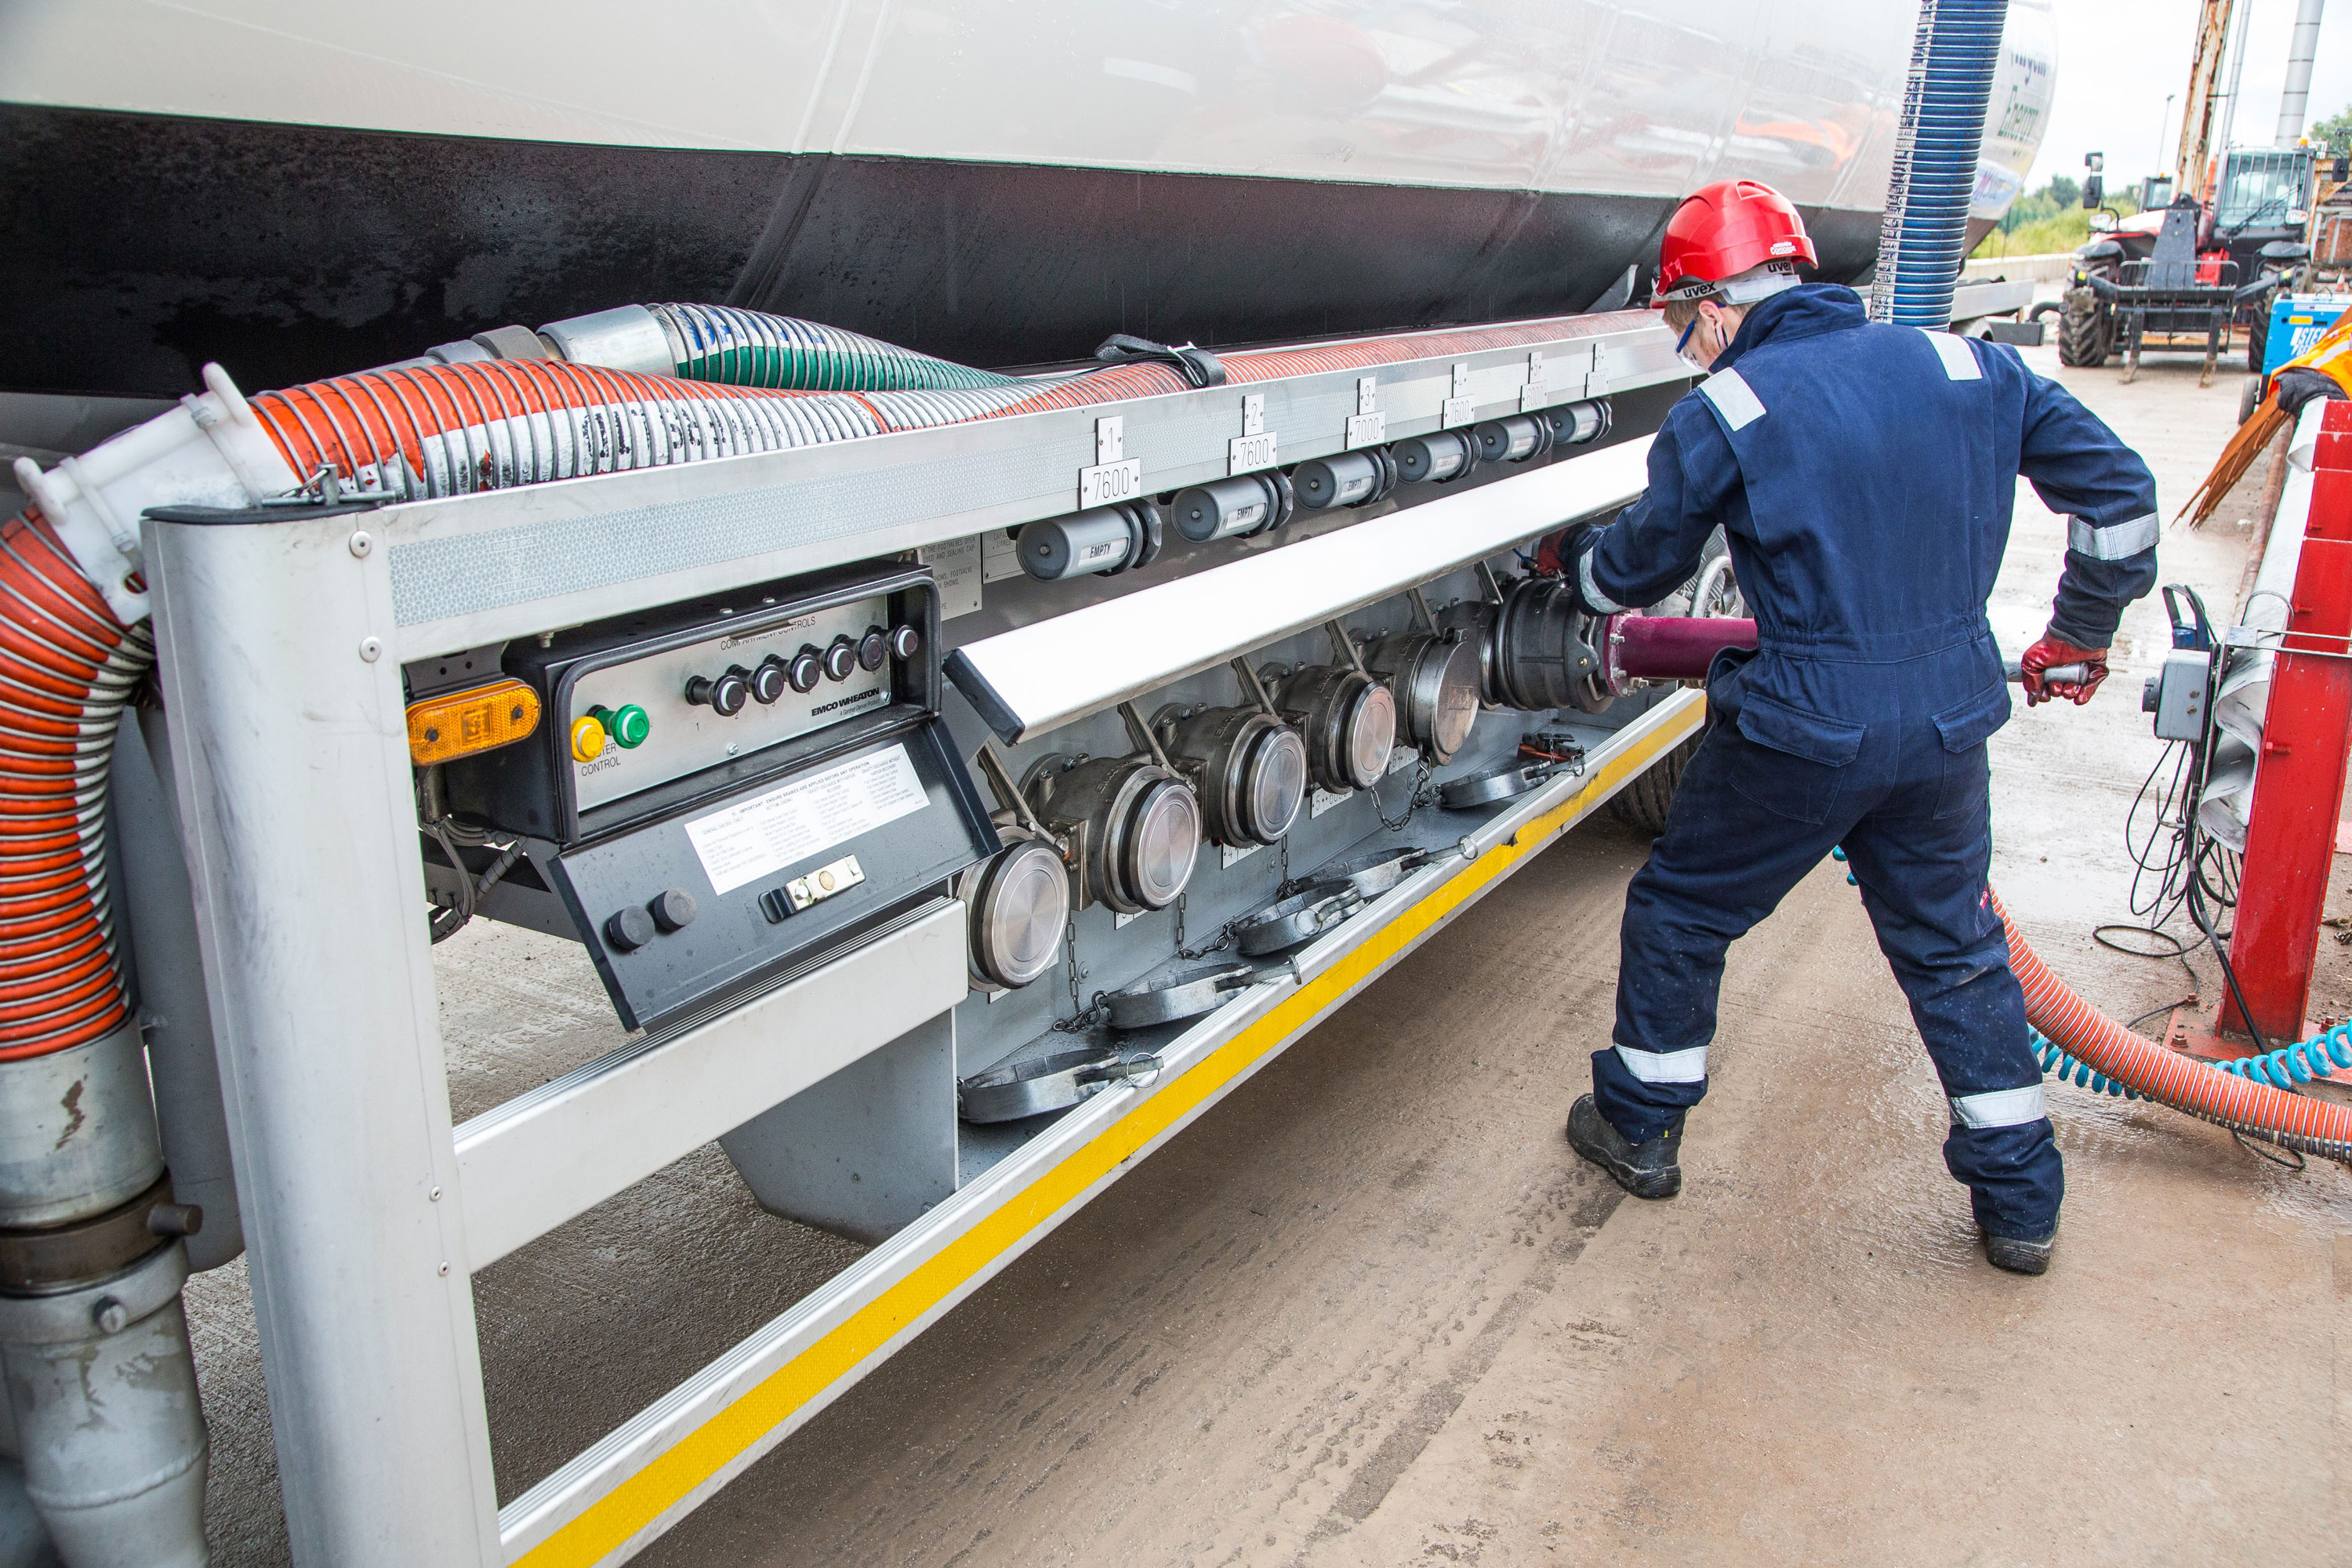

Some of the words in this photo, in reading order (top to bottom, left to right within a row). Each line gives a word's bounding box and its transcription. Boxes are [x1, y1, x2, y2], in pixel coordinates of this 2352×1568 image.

[1683, 281, 1716, 298] uvex
[1597, 349, 1602, 365] 6
[1534, 358, 1538, 376] 5
[1457, 375, 1463, 389] 4
[1592, 374, 1606, 393] 7000
[1364, 385, 1370, 406] 3
[1526, 385, 1544, 407] 6000
[1251, 403, 1258, 426] 2
[1450, 400, 1469, 423] 7600
[1356, 417, 1379, 443] 7000
[1108, 426, 1113, 452] 1
[1241, 438, 1269, 467] 7600
[1093, 466, 1130, 501] 7600
[1348, 478, 1363, 492] EMPTY
[1236, 505, 1254, 520] EMPTY
[938, 539, 963, 550] FOOTVALVES
[964, 536, 976, 545] OPEN
[996, 539, 1011, 548] LITRES
[1090, 543, 1112, 558] EMPTY
[947, 547, 964, 557] SEALING
[950, 566, 973, 577] FOOTVALVE
[811, 702, 839, 717] EMCO
[839, 687, 880, 707] WHEATON
[843, 706, 856, 716] Gardner
[696, 722, 699, 731] 1
[581, 757, 621, 776] CONTROL
[1392, 753, 1396, 768] 6
[739, 801, 764, 814] IMPORTANT
[765, 794, 782, 803] ENSURE
[782, 787, 799, 797] BRAKES
[808, 778, 824, 787] APPLIED
[824, 772, 839, 781] BEFORE
[848, 760, 869, 771] OPERATION
[1316, 794, 1320, 811] 5
